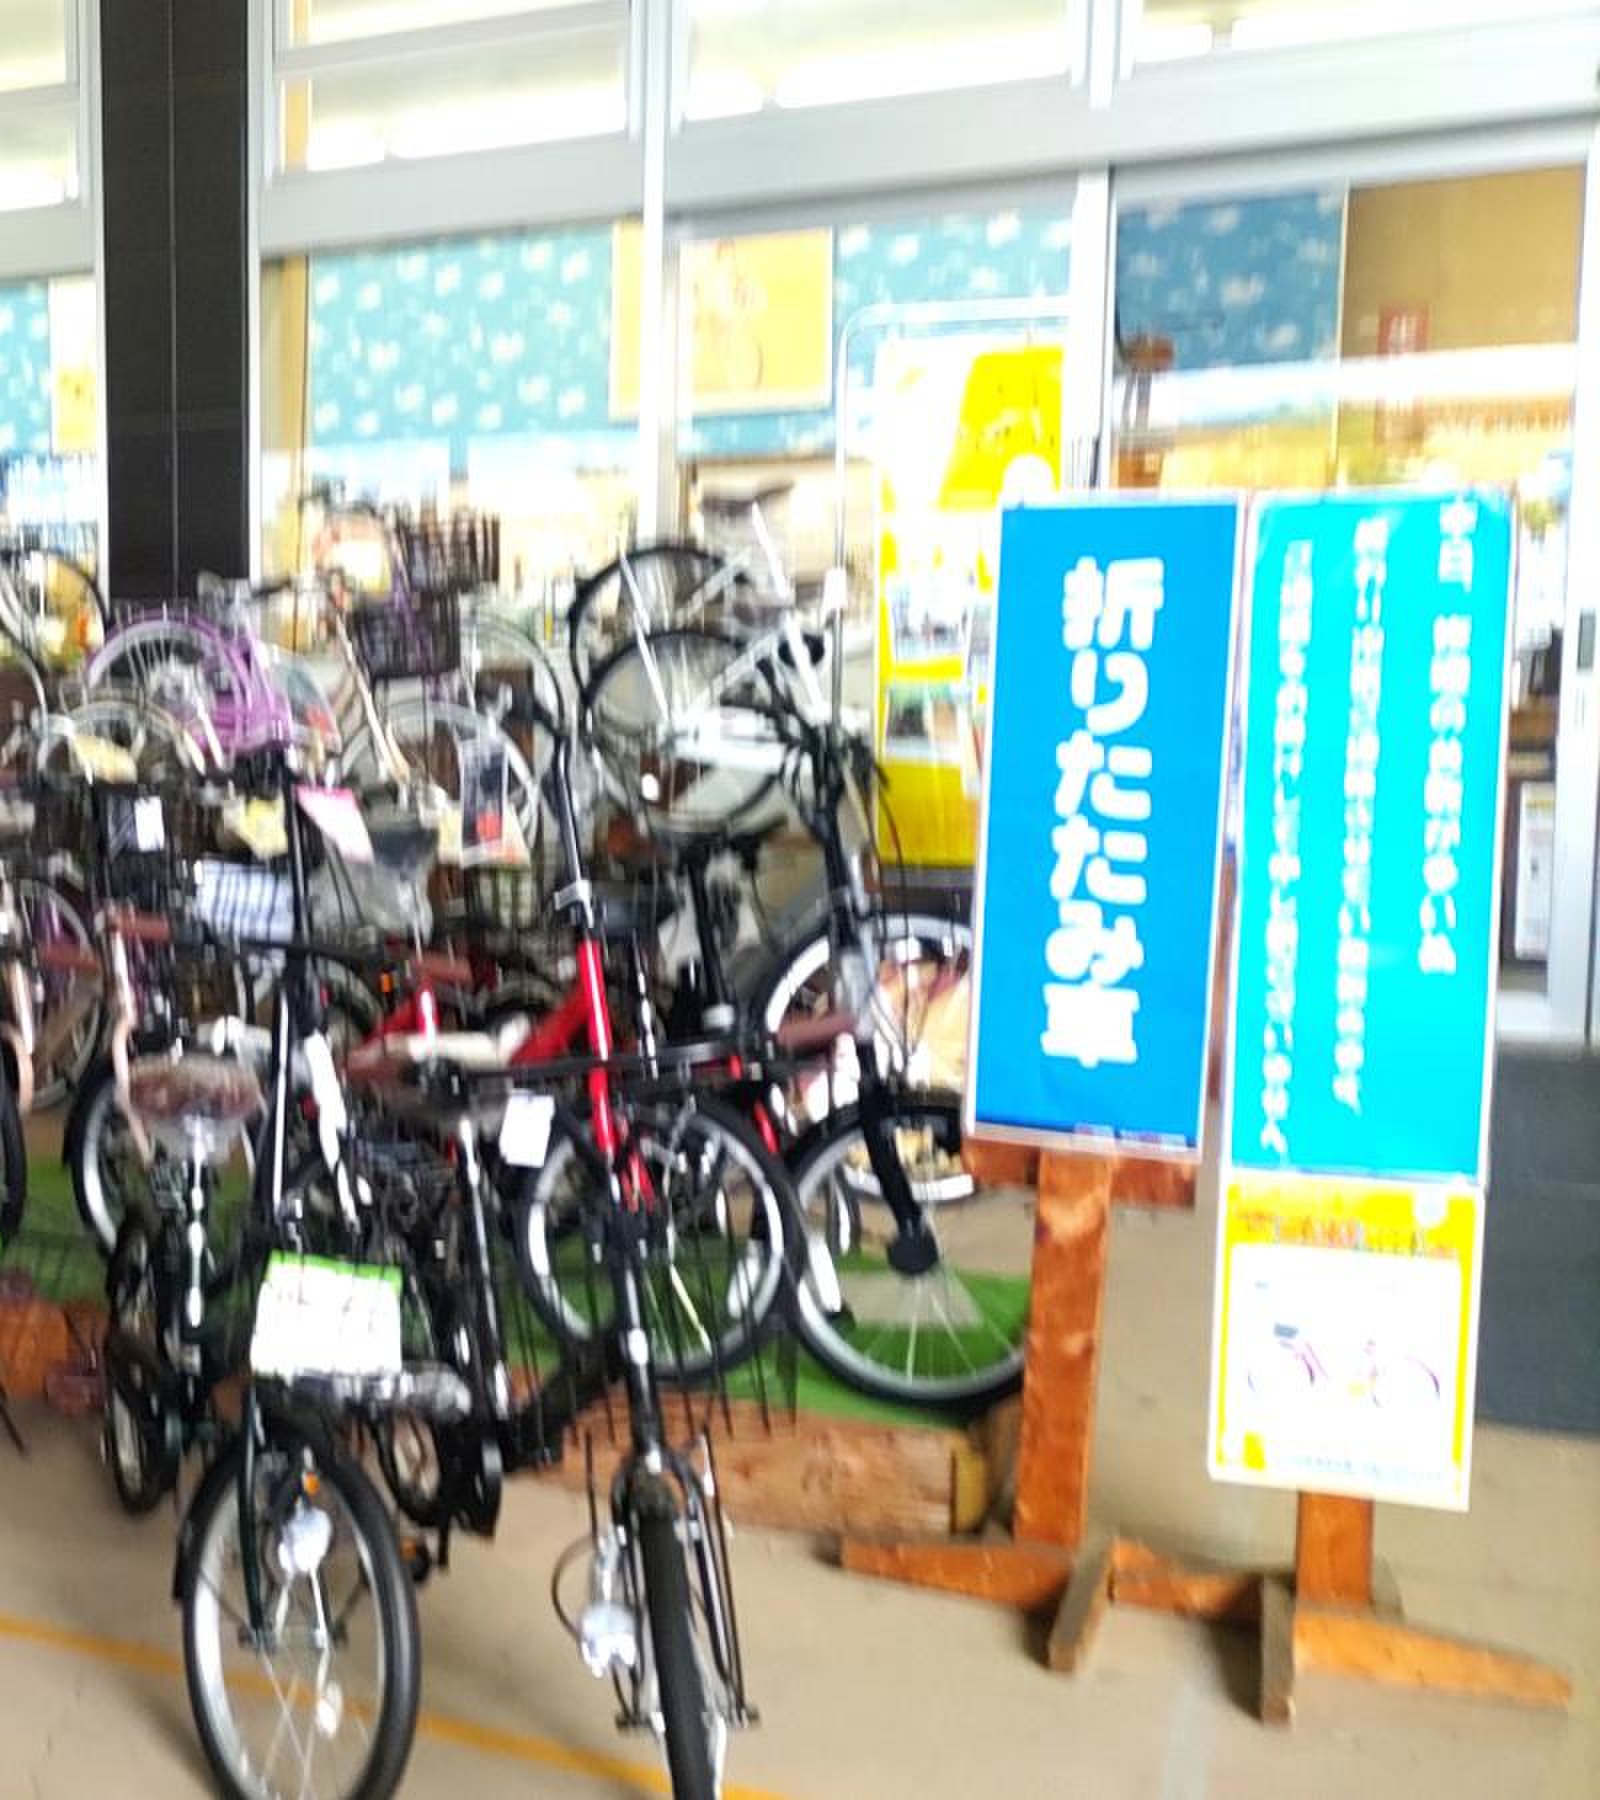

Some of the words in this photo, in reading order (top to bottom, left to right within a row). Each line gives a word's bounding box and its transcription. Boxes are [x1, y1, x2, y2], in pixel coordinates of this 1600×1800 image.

[1040, 556, 1164, 1068] 折りたたみ車
